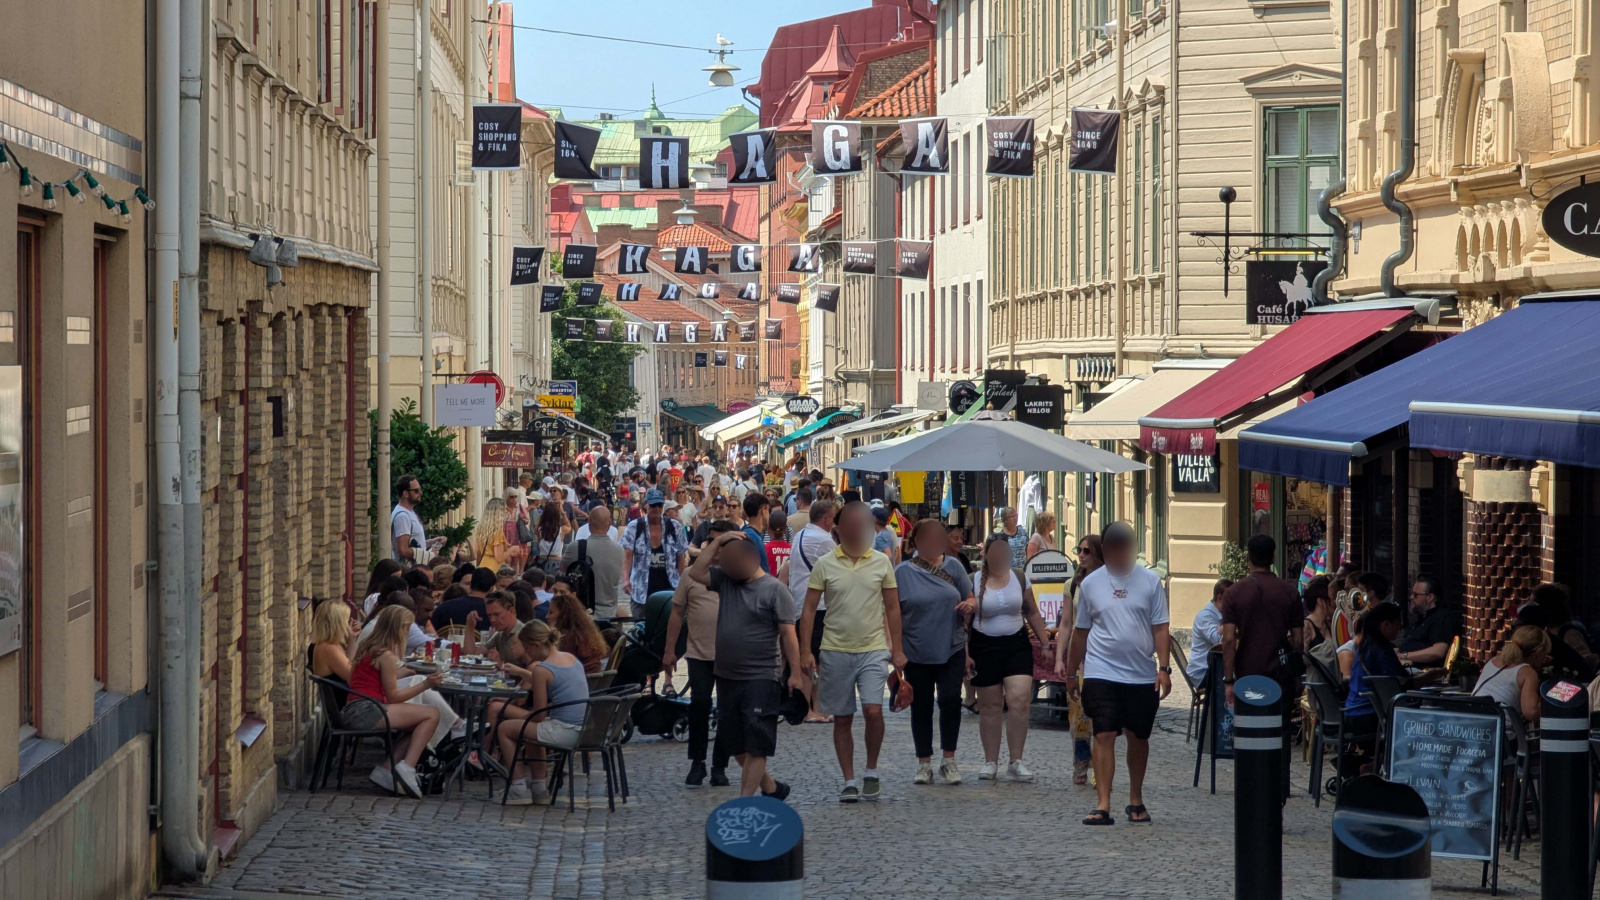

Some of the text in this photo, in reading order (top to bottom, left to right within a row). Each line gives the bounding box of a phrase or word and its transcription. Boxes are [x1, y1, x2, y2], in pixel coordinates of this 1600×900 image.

[478, 122, 500, 131] COSY
[478, 133, 517, 142] SHOPPING
[994, 132, 1014, 140] COSY
[1077, 130, 1101, 140] SINCE
[488, 143, 507, 152] FIKA
[822, 124, 851, 171] G
[911, 122, 941, 168] A
[994, 140, 1031, 150] SHOPPING
[1077, 140, 1098, 149] 1648
[738, 134, 770, 180] A
[1002, 150, 1021, 159] FIKA
[651, 141, 682, 188] H
[626, 245, 644, 272] H
[681, 246, 700, 272] A
[737, 245, 755, 270] G
[622, 283, 638, 300] H
[1257, 304, 1282, 314] Café
[1257, 315, 1304, 324] HUSAR
[627, 324, 638, 342] H
[656, 324, 667, 342] A
[686, 324, 696, 342] G
[714, 324, 724, 341] A
[539, 398, 573, 408] Cyklar
[535, 420, 558, 429] CAFÉ
[1178, 454, 1212, 467] VILLER
[1040, 601, 1064, 620] SAL
[1404, 720, 1492, 742] GRILLED SANDWICHES
[1412, 742, 1486, 758] HOMEMADE FOCACCIA
[1410, 776, 1441, 788] LEVAIN
